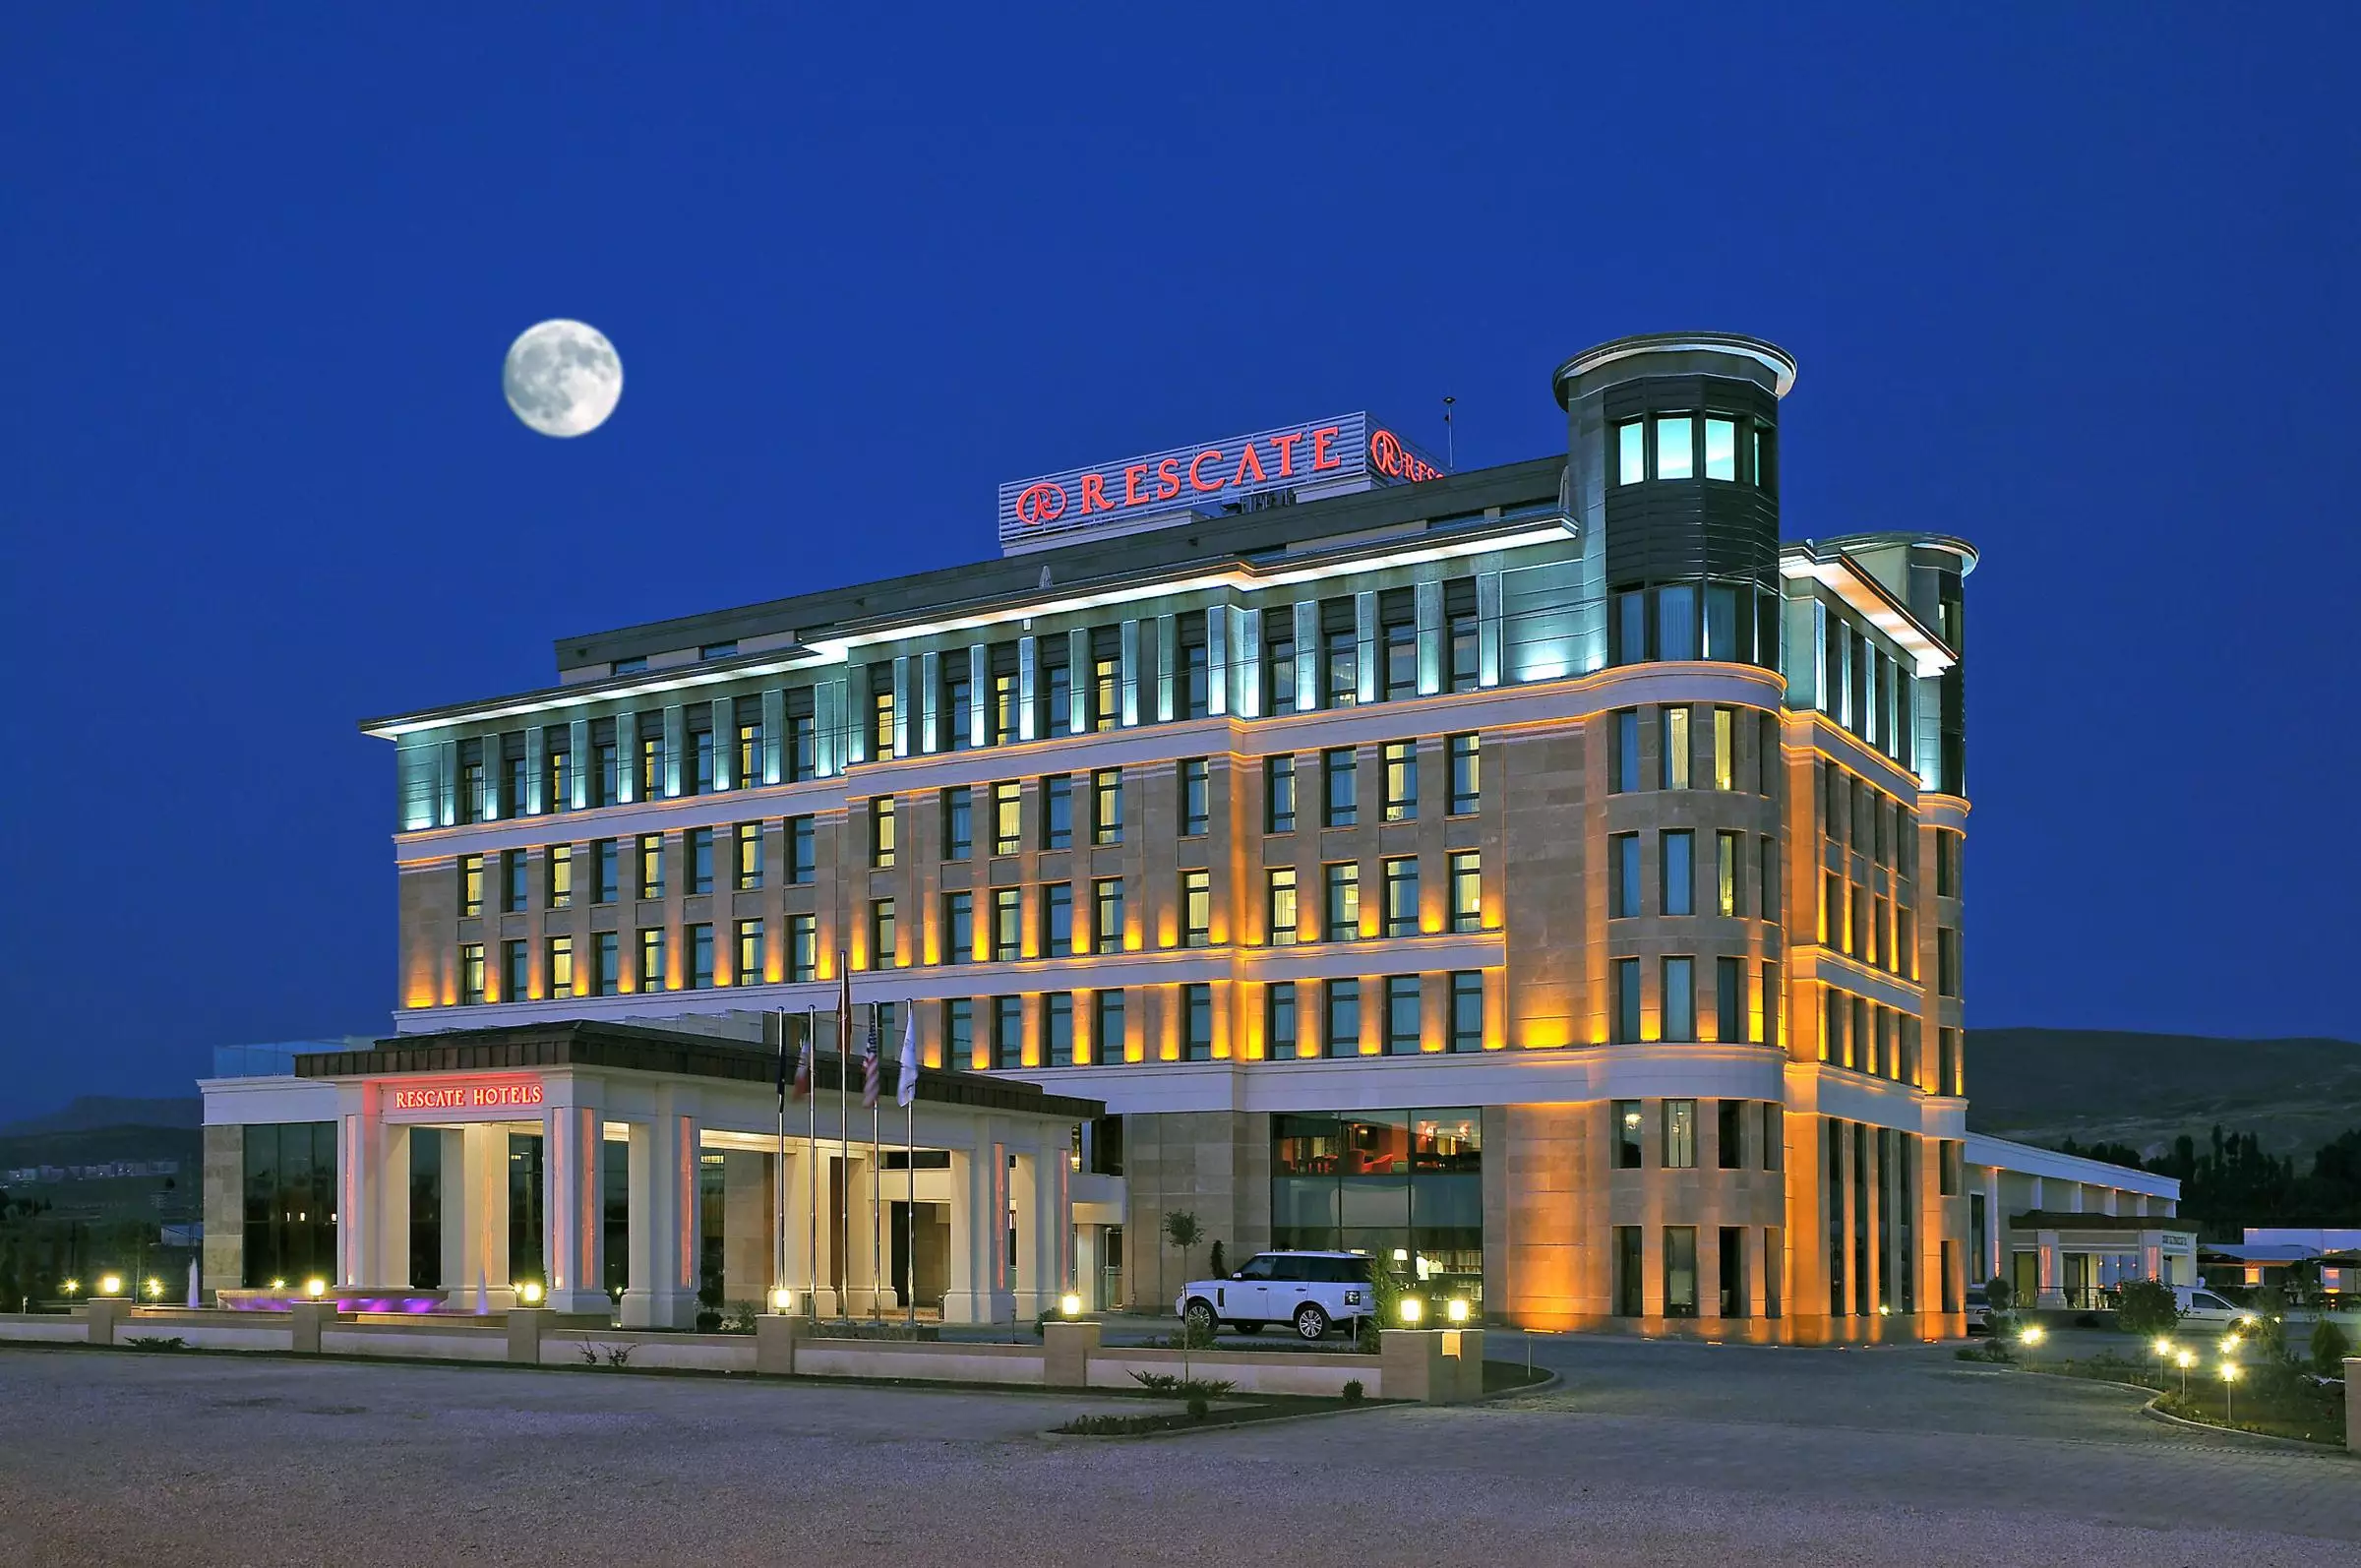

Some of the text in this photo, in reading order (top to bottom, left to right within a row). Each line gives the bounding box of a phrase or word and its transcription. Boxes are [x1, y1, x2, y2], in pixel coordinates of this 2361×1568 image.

[1080, 426, 1341, 514] RESCATE
[395, 1085, 543, 1108] RESCATE HOTELS
